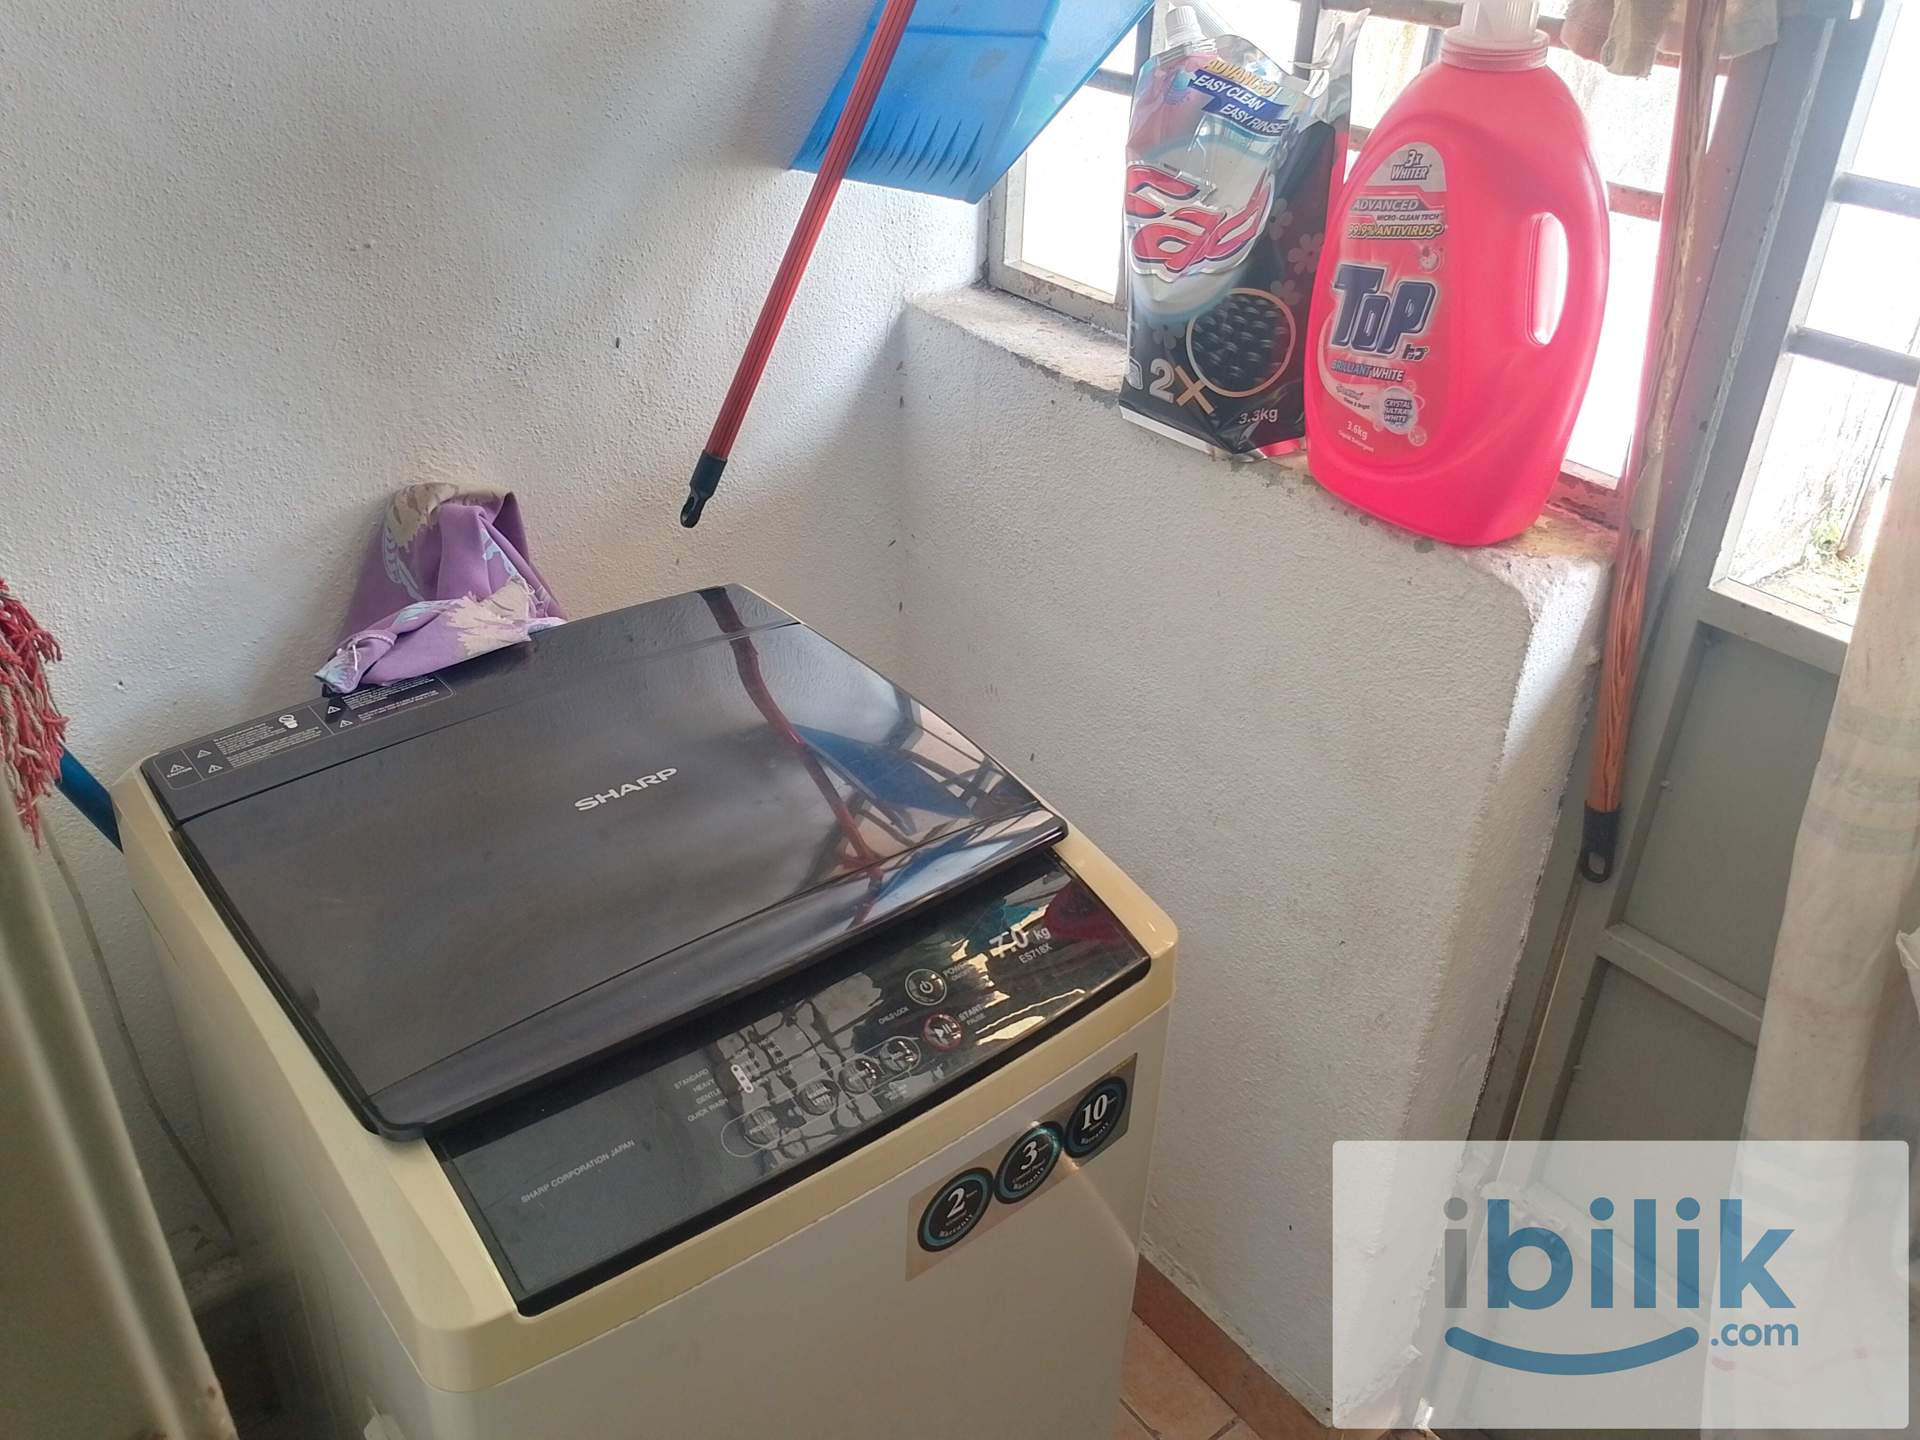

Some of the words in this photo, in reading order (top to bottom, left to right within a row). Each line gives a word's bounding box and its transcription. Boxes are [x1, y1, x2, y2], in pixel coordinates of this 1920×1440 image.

[1193, 75, 1232, 93] EASY
[1226, 87, 1266, 111] CLEAN
[1220, 104, 1253, 123] EASY
[1247, 118, 1288, 133] RINSE
[1352, 200, 1419, 212] ADVANCED
[1370, 367, 1405, 383] WHITE
[1239, 408, 1278, 425] 3.3kg
[574, 767, 678, 811] SHARP
[1033, 927, 1052, 941] kg
[1081, 1094, 1108, 1131] 10
[1021, 1141, 1038, 1170] 3
[521, 1183, 550, 1203] SHARP
[550, 1153, 610, 1188] CORPORATION
[611, 1139, 635, 1157] JAPAN
[946, 1187, 966, 1219] 2
